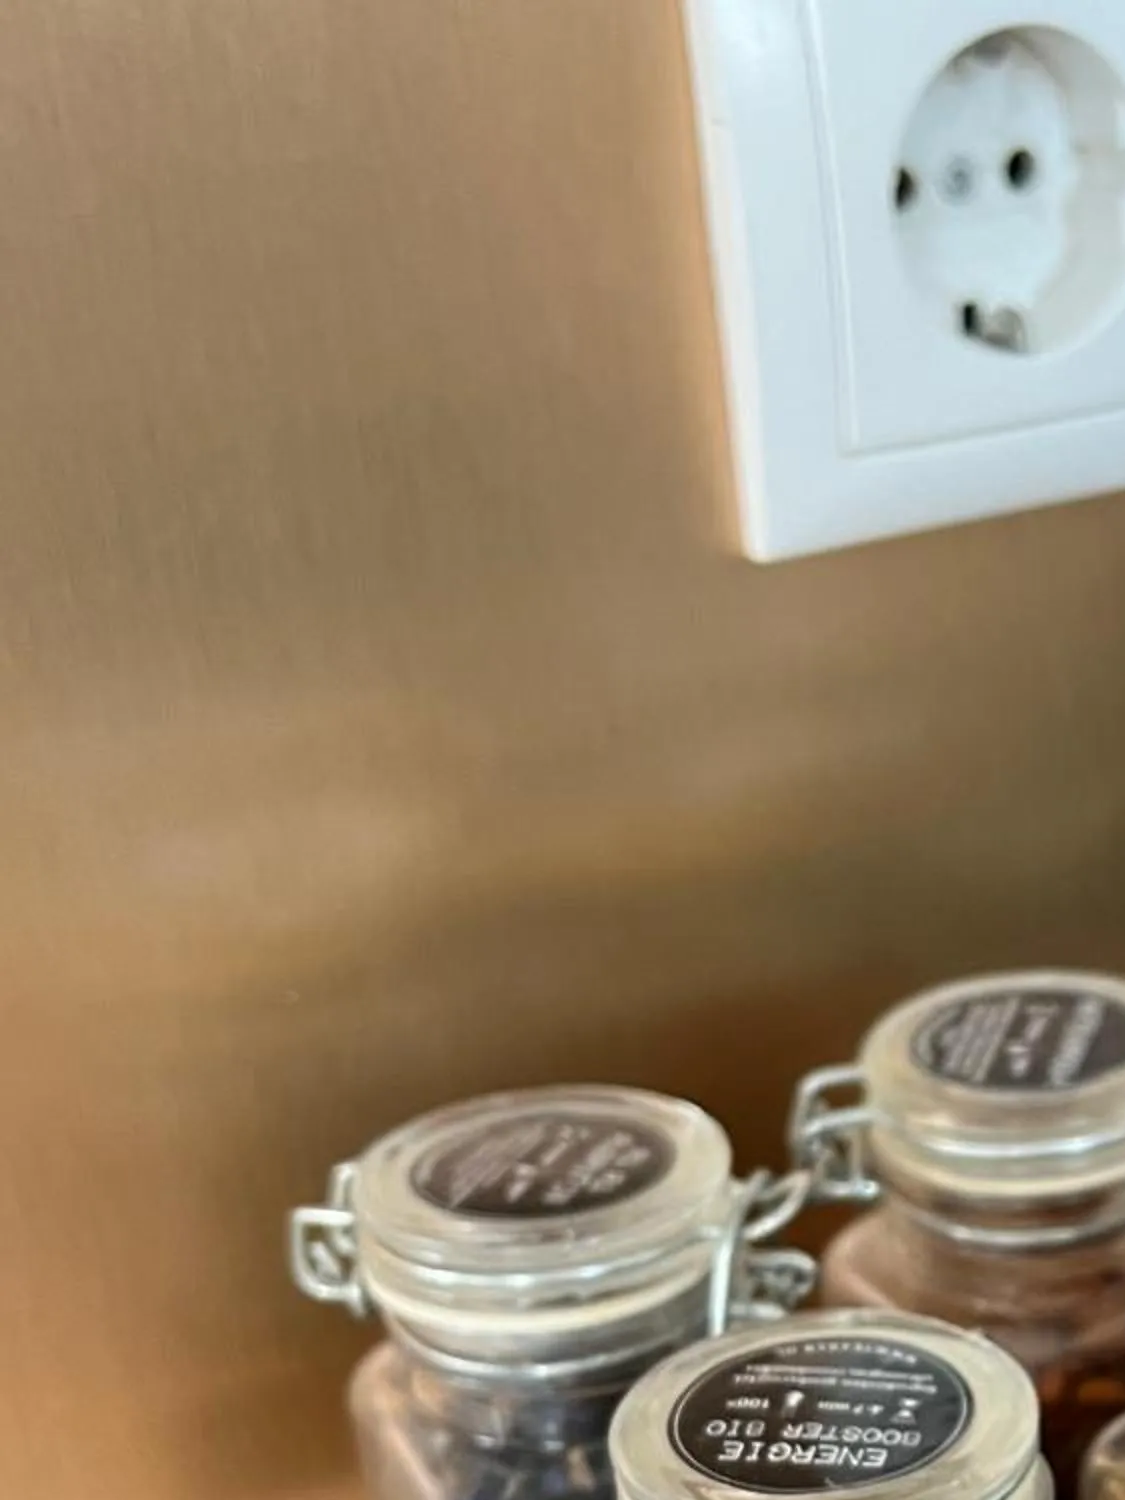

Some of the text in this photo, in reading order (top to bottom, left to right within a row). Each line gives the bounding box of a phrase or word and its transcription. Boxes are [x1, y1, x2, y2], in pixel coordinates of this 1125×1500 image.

[706, 1419, 922, 1446] BOOSTER BIO
[718, 1440, 888, 1467] ENERGIE
